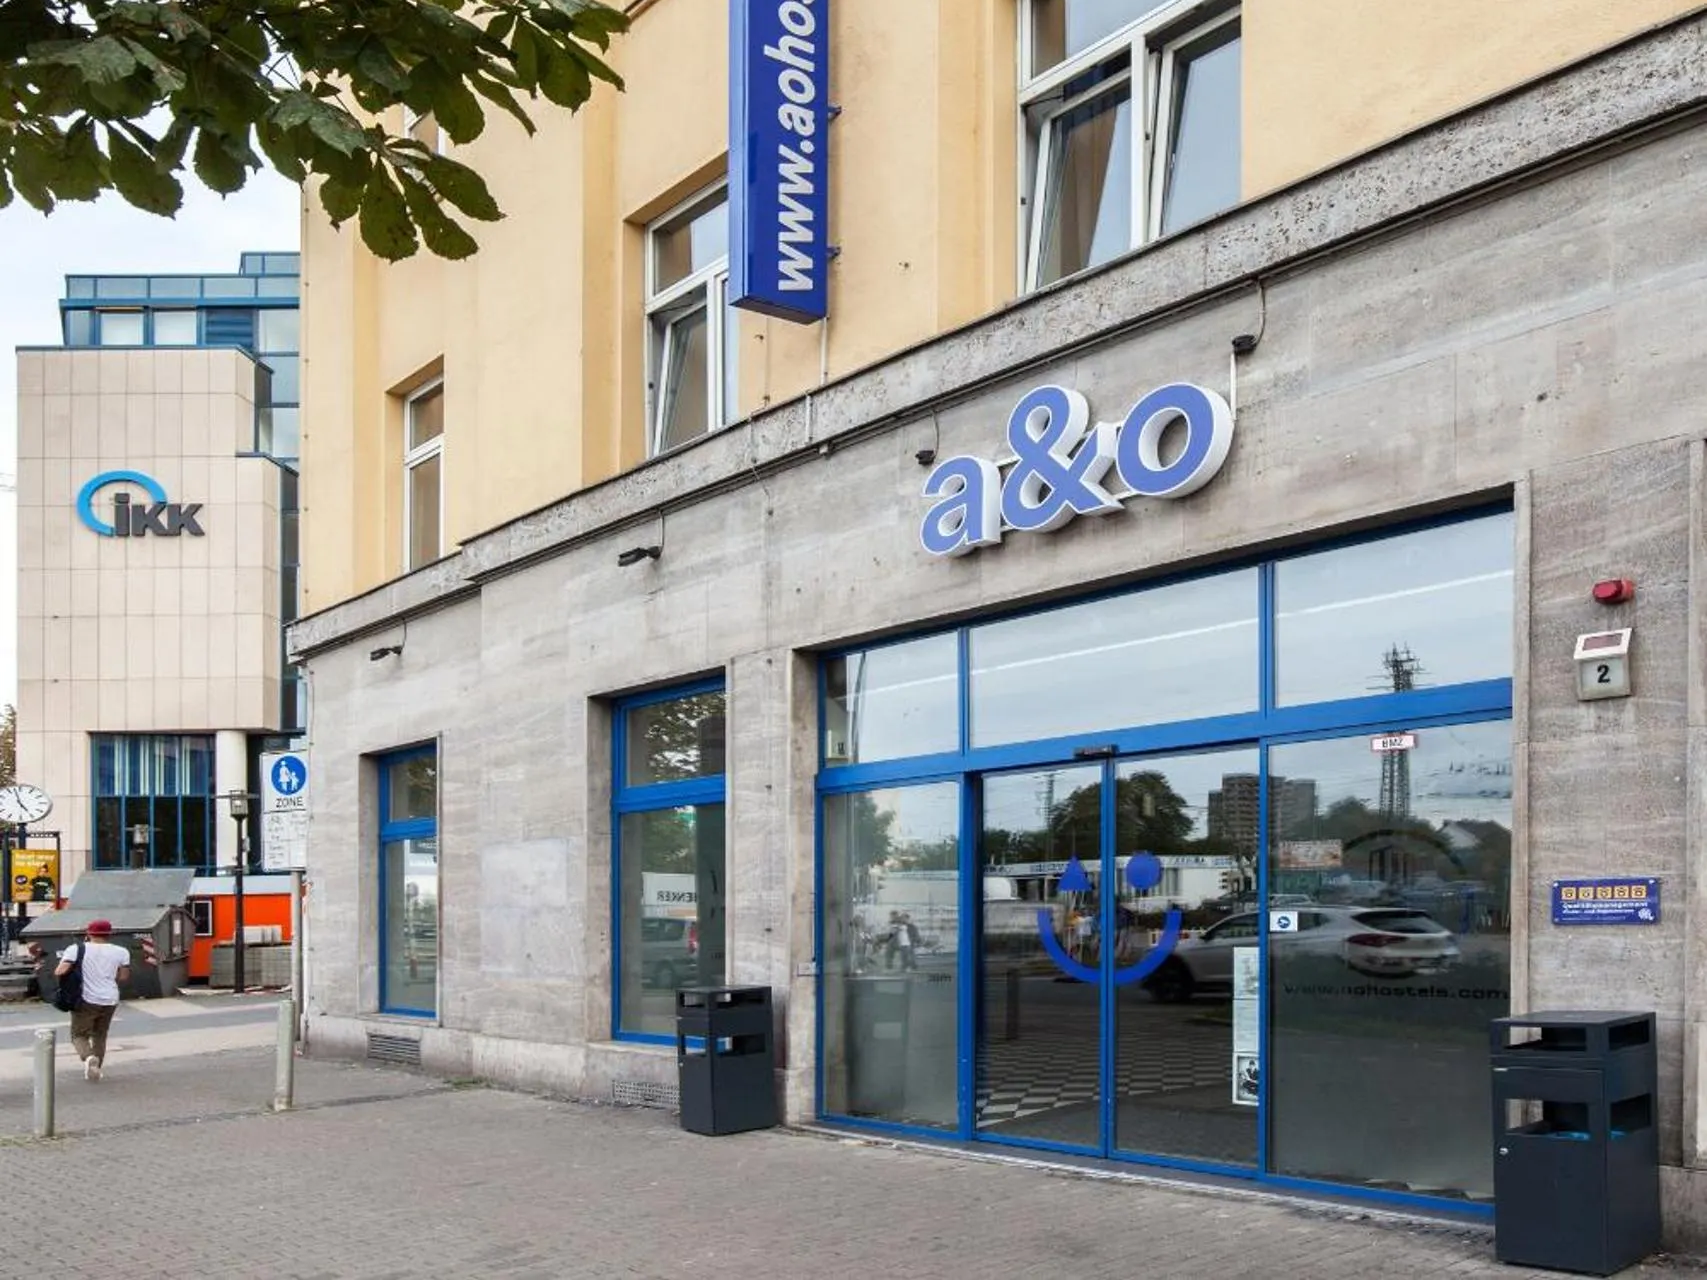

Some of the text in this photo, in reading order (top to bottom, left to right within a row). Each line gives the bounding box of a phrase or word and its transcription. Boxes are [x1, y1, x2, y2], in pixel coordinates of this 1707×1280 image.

[920, 382, 1235, 557] a&o
[1596, 664, 1611, 684] 2
[275, 796, 305, 808] ZONE
